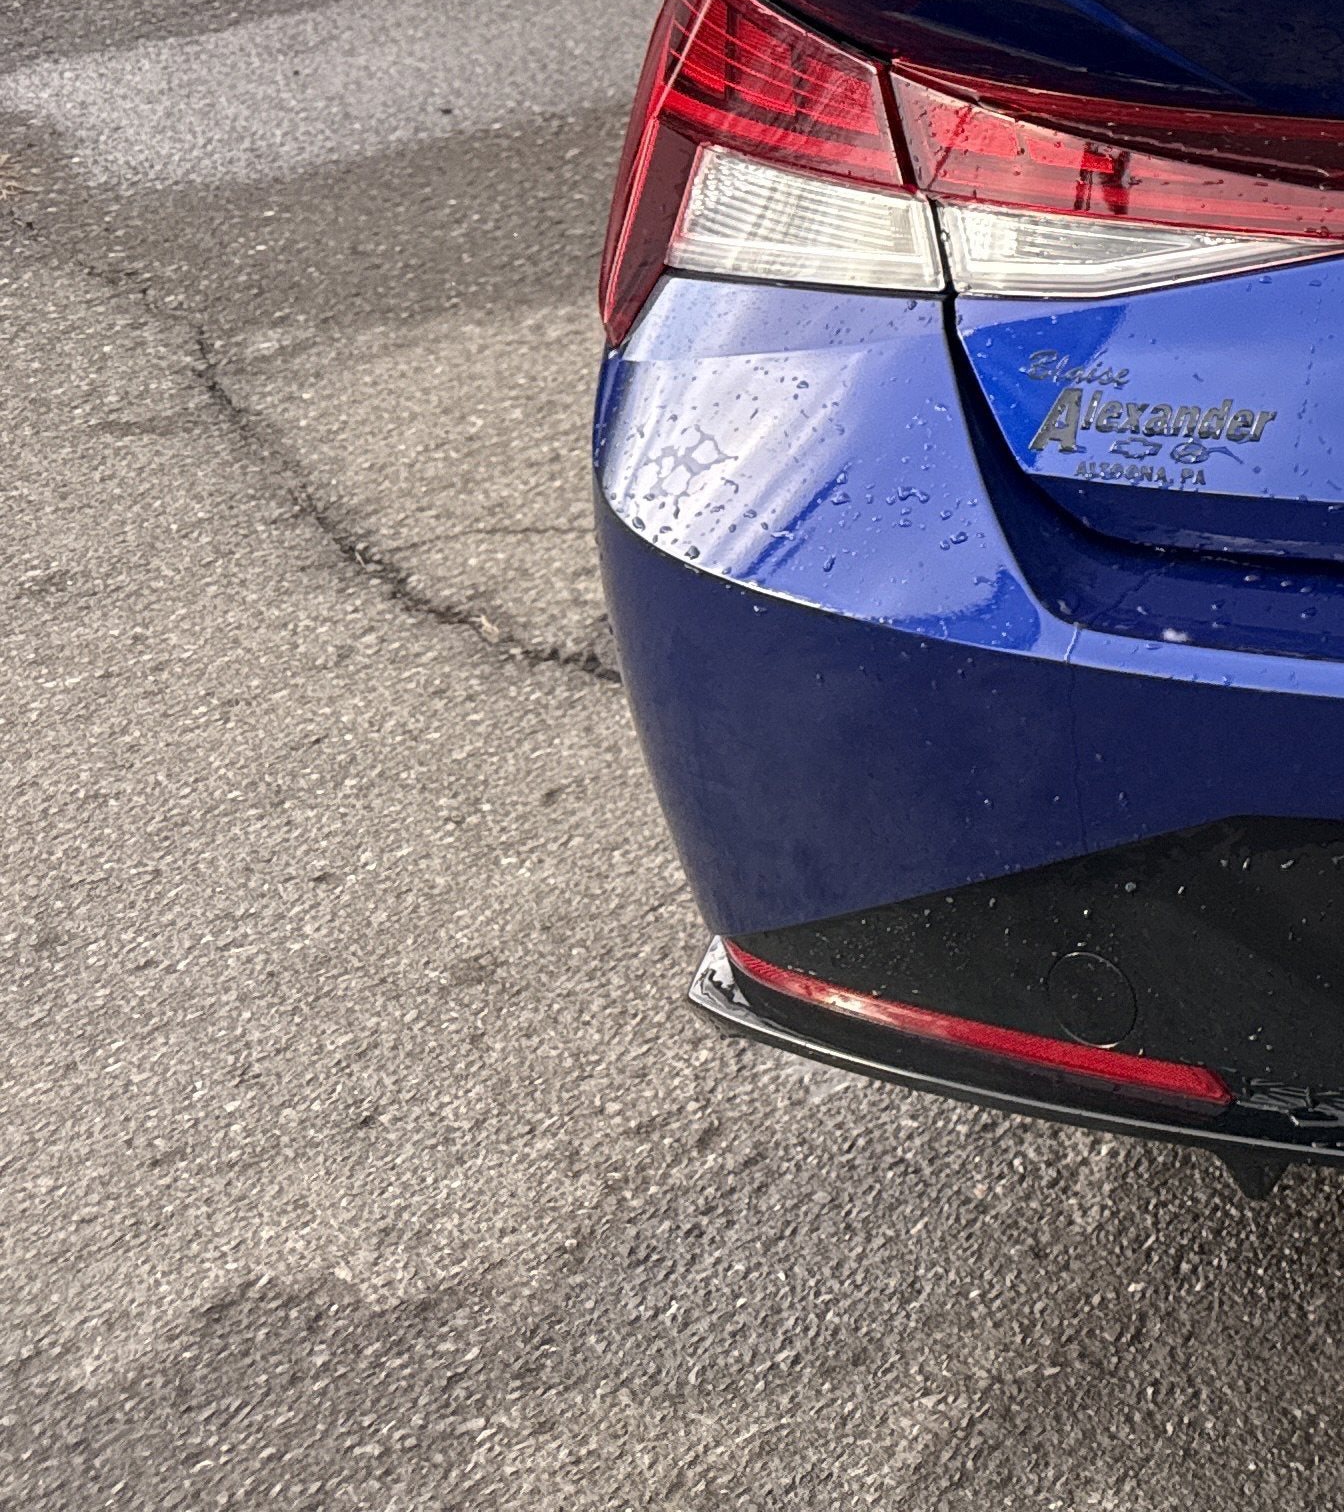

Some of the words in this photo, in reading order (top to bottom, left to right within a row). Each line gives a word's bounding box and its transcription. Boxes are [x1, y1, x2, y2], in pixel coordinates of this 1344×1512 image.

[1027, 348, 1130, 386] Blaise
[1027, 387, 1277, 454] Alexander
[1180, 466, 1206, 486] PA
